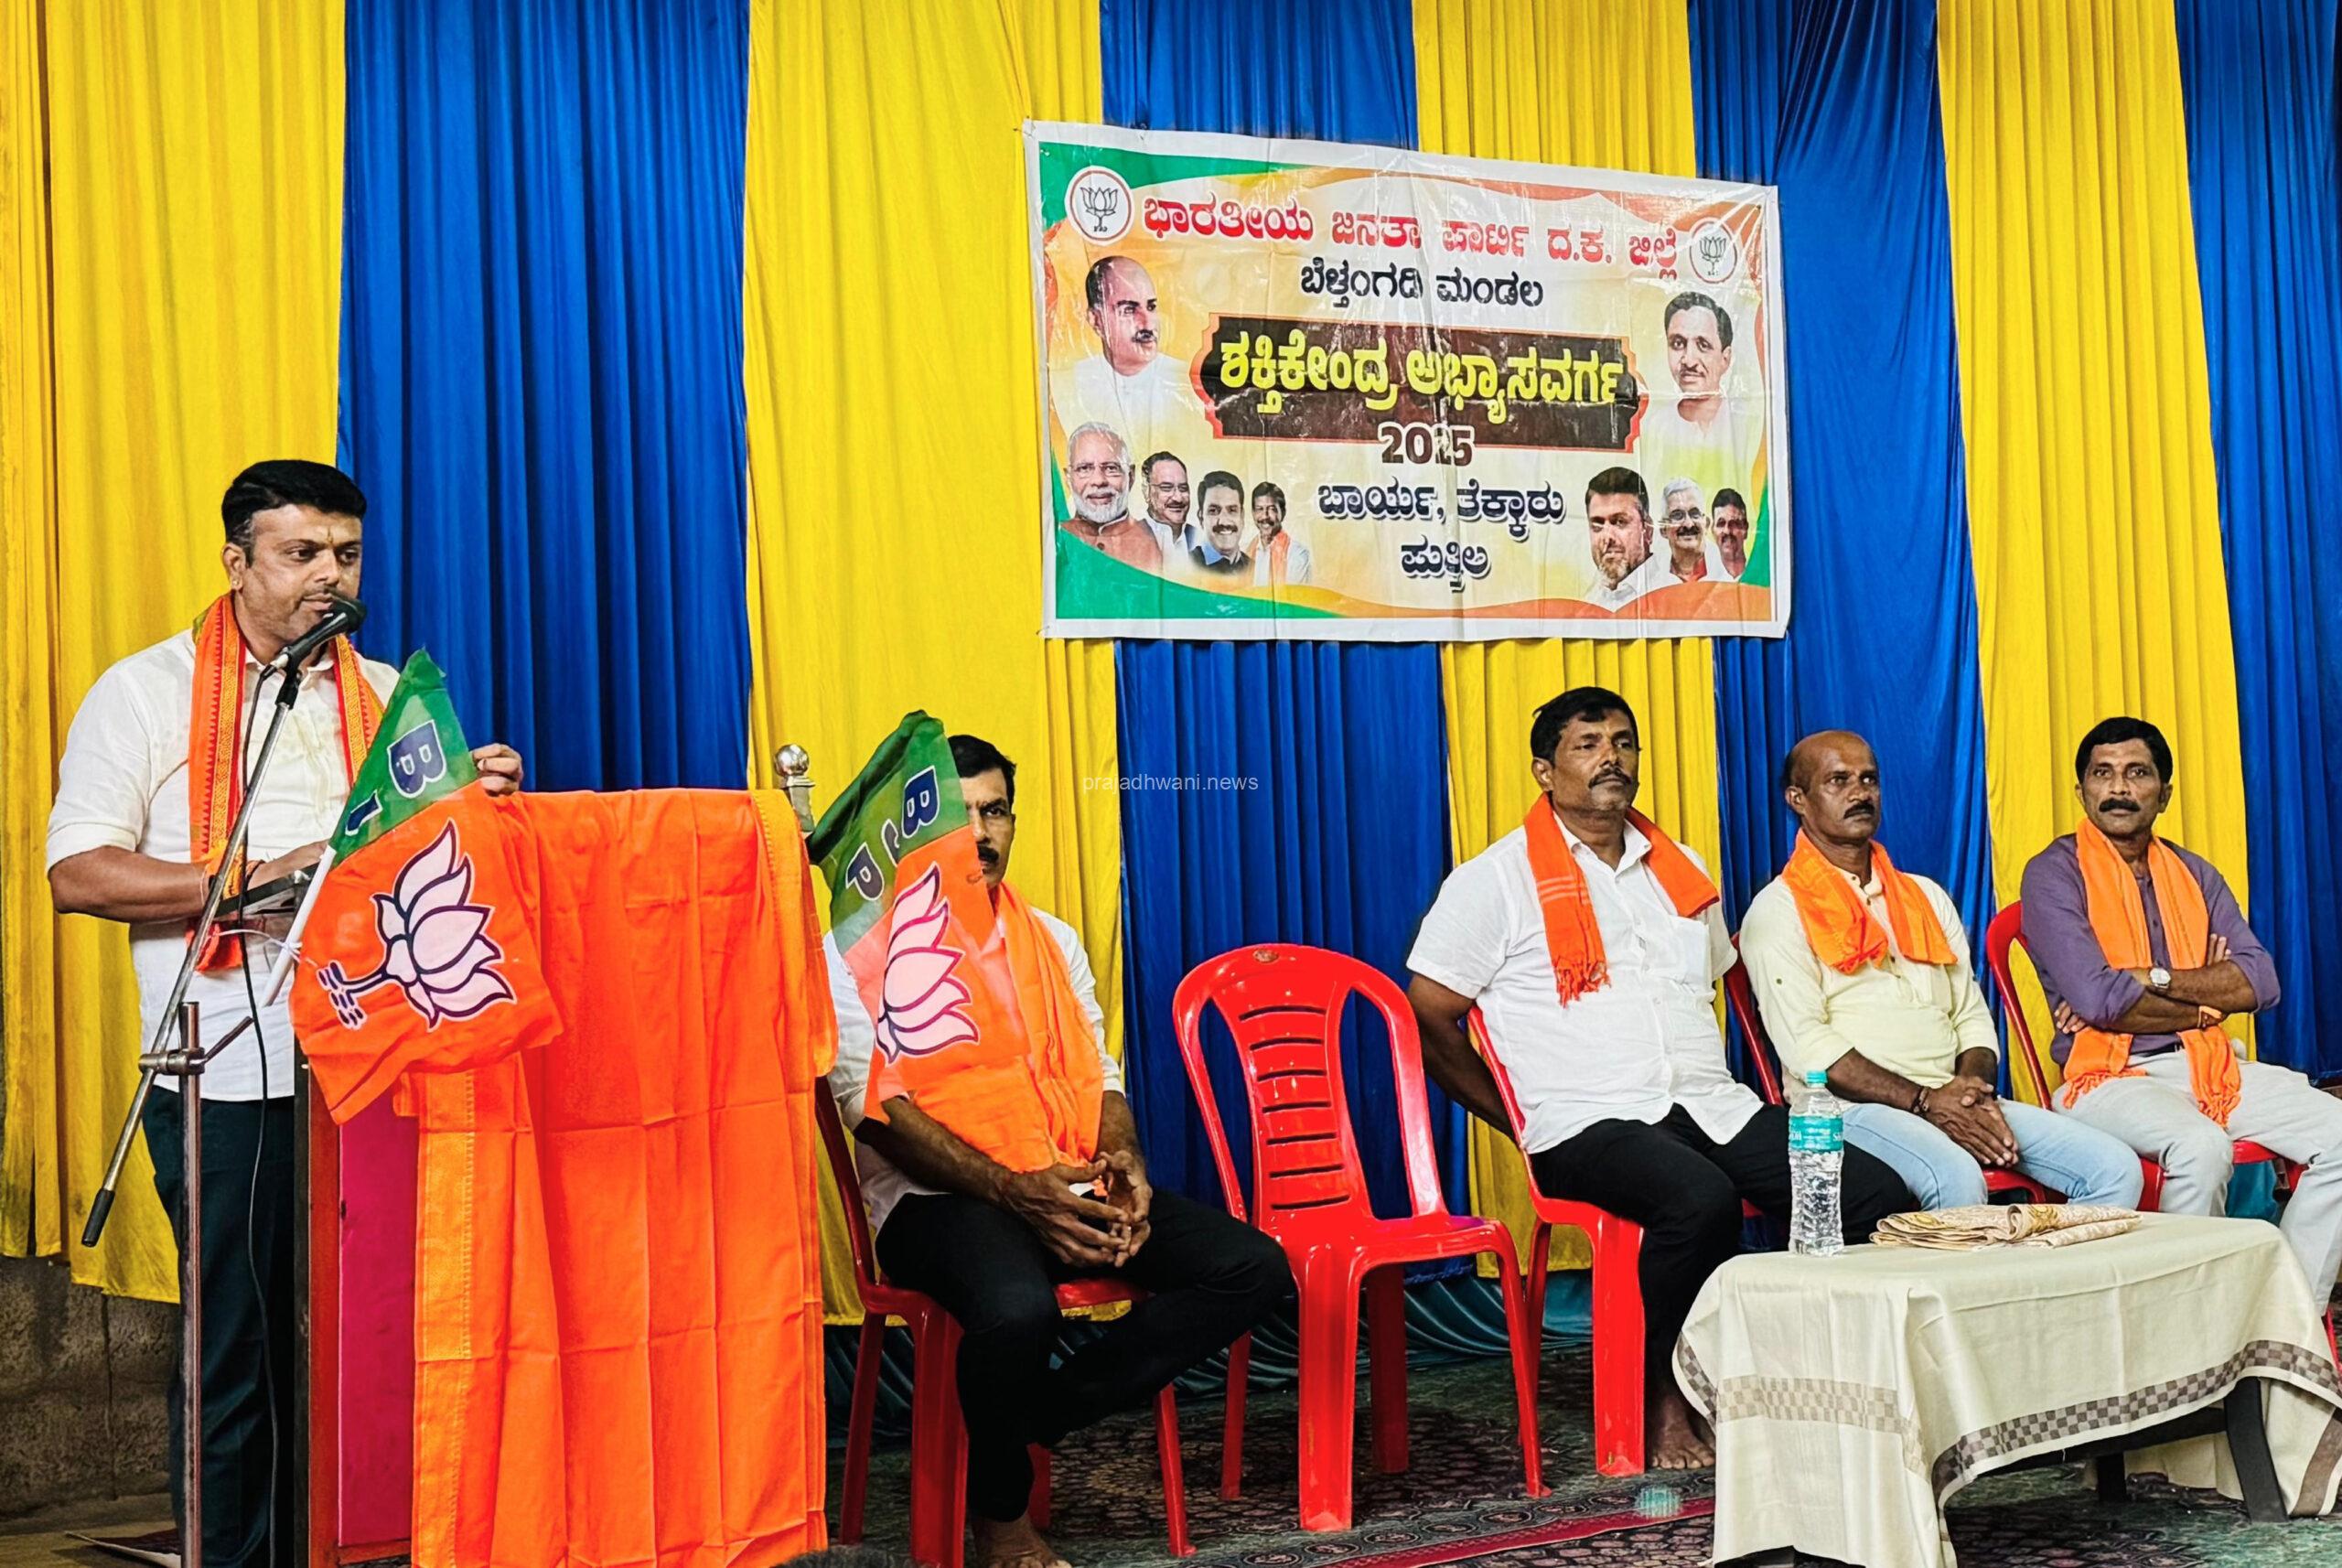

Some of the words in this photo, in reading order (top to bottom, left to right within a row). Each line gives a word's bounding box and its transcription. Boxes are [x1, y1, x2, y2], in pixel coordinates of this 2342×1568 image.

[1144, 191, 1314, 241] ಭಾರತೀಯ
[1332, 209, 1422, 249] ಜನತಾ
[1442, 219, 1530, 257] ಪಾರ್ಟಿ
[1628, 227, 1678, 281] ಜಿಲ್ಲೆ
[1300, 256, 1423, 308] ಬೆಳ್ತಂಗಡಿ
[1435, 266, 1544, 307] ಮಂಡಲ
[1220, 328, 1399, 414] ಶಕ್ತಿಕೇಂದ್ರ
